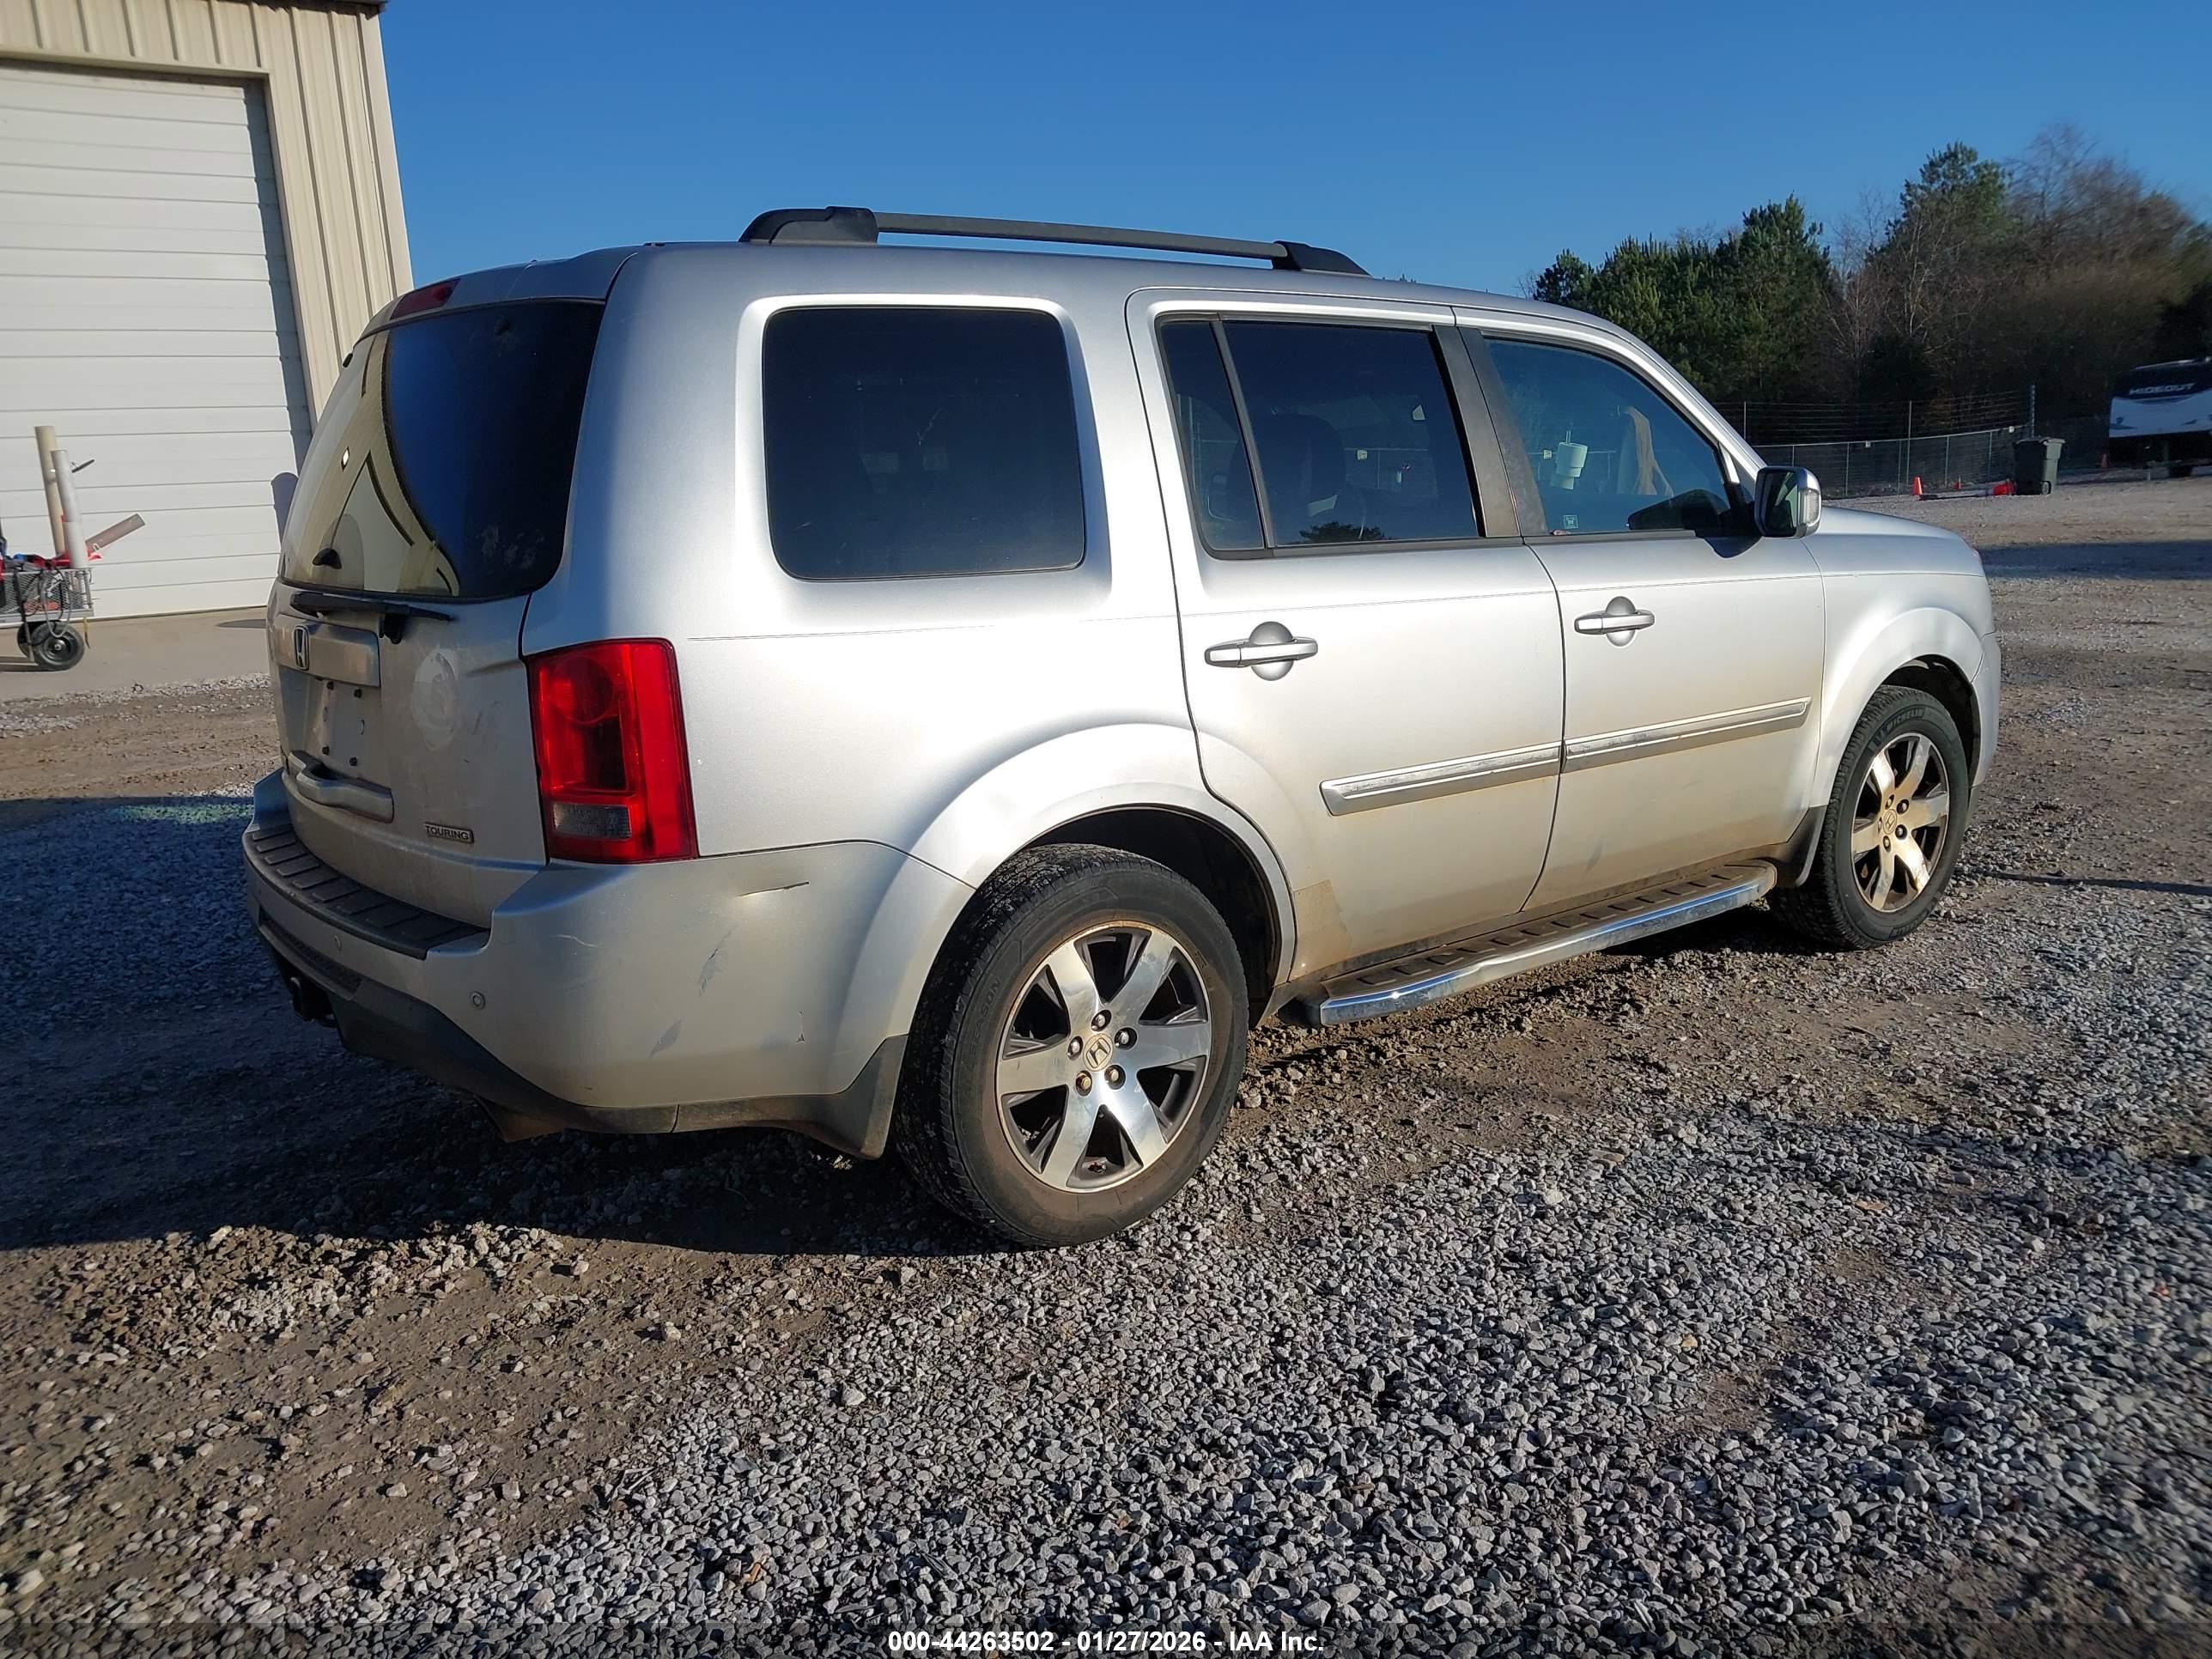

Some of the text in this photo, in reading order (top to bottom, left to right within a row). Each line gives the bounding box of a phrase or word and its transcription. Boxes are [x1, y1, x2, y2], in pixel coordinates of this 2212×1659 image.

[2130, 383, 2196, 395] HIDEOUT
[1886, 707, 1926, 733] MICHELIN
[425, 825, 470, 841] TOURING
